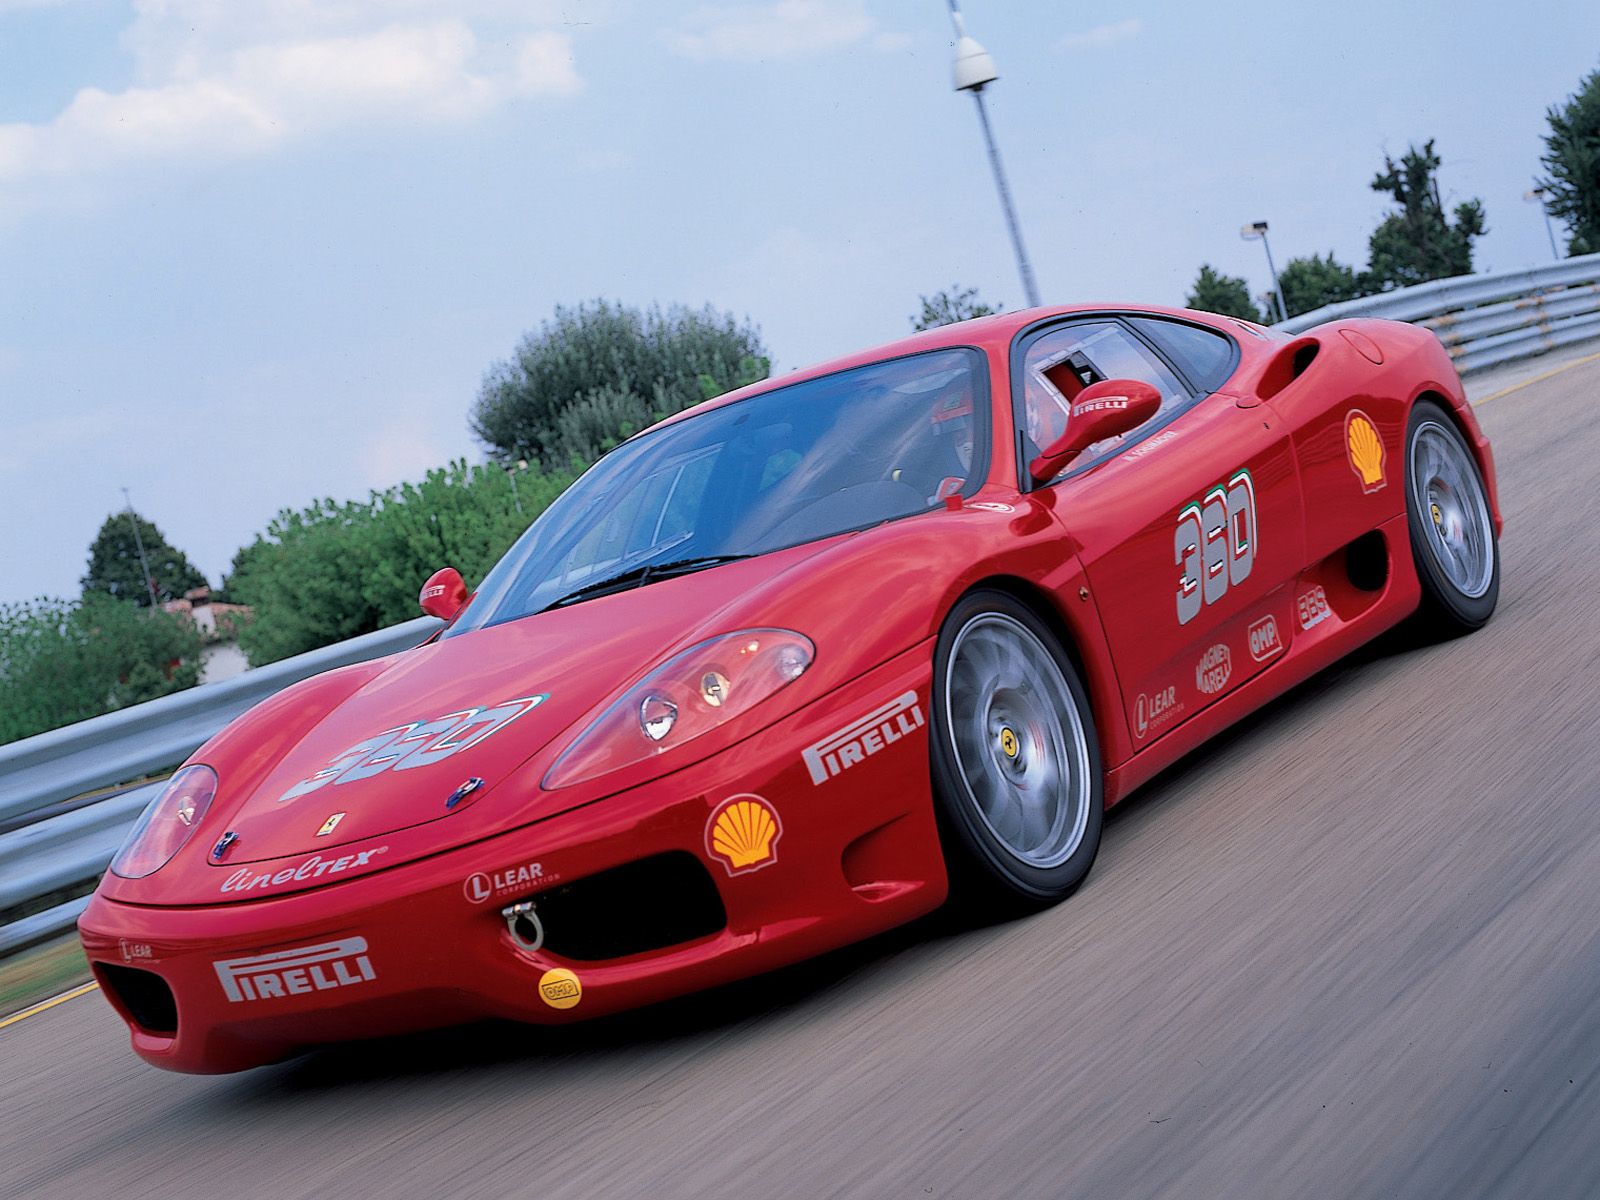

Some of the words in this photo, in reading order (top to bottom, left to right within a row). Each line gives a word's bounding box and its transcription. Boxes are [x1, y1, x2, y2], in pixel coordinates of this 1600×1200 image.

[1074, 396, 1129, 417] PIRELLI
[1174, 467, 1258, 626] 360
[1298, 585, 1332, 630] BBS
[1250, 621, 1278, 655] OMP
[1150, 686, 1176, 718] LEAR
[278, 693, 551, 802] 360
[801, 690, 925, 786] PIRELLI
[494, 863, 544, 890] LEAR
[212, 935, 377, 1002] PIRELLI
